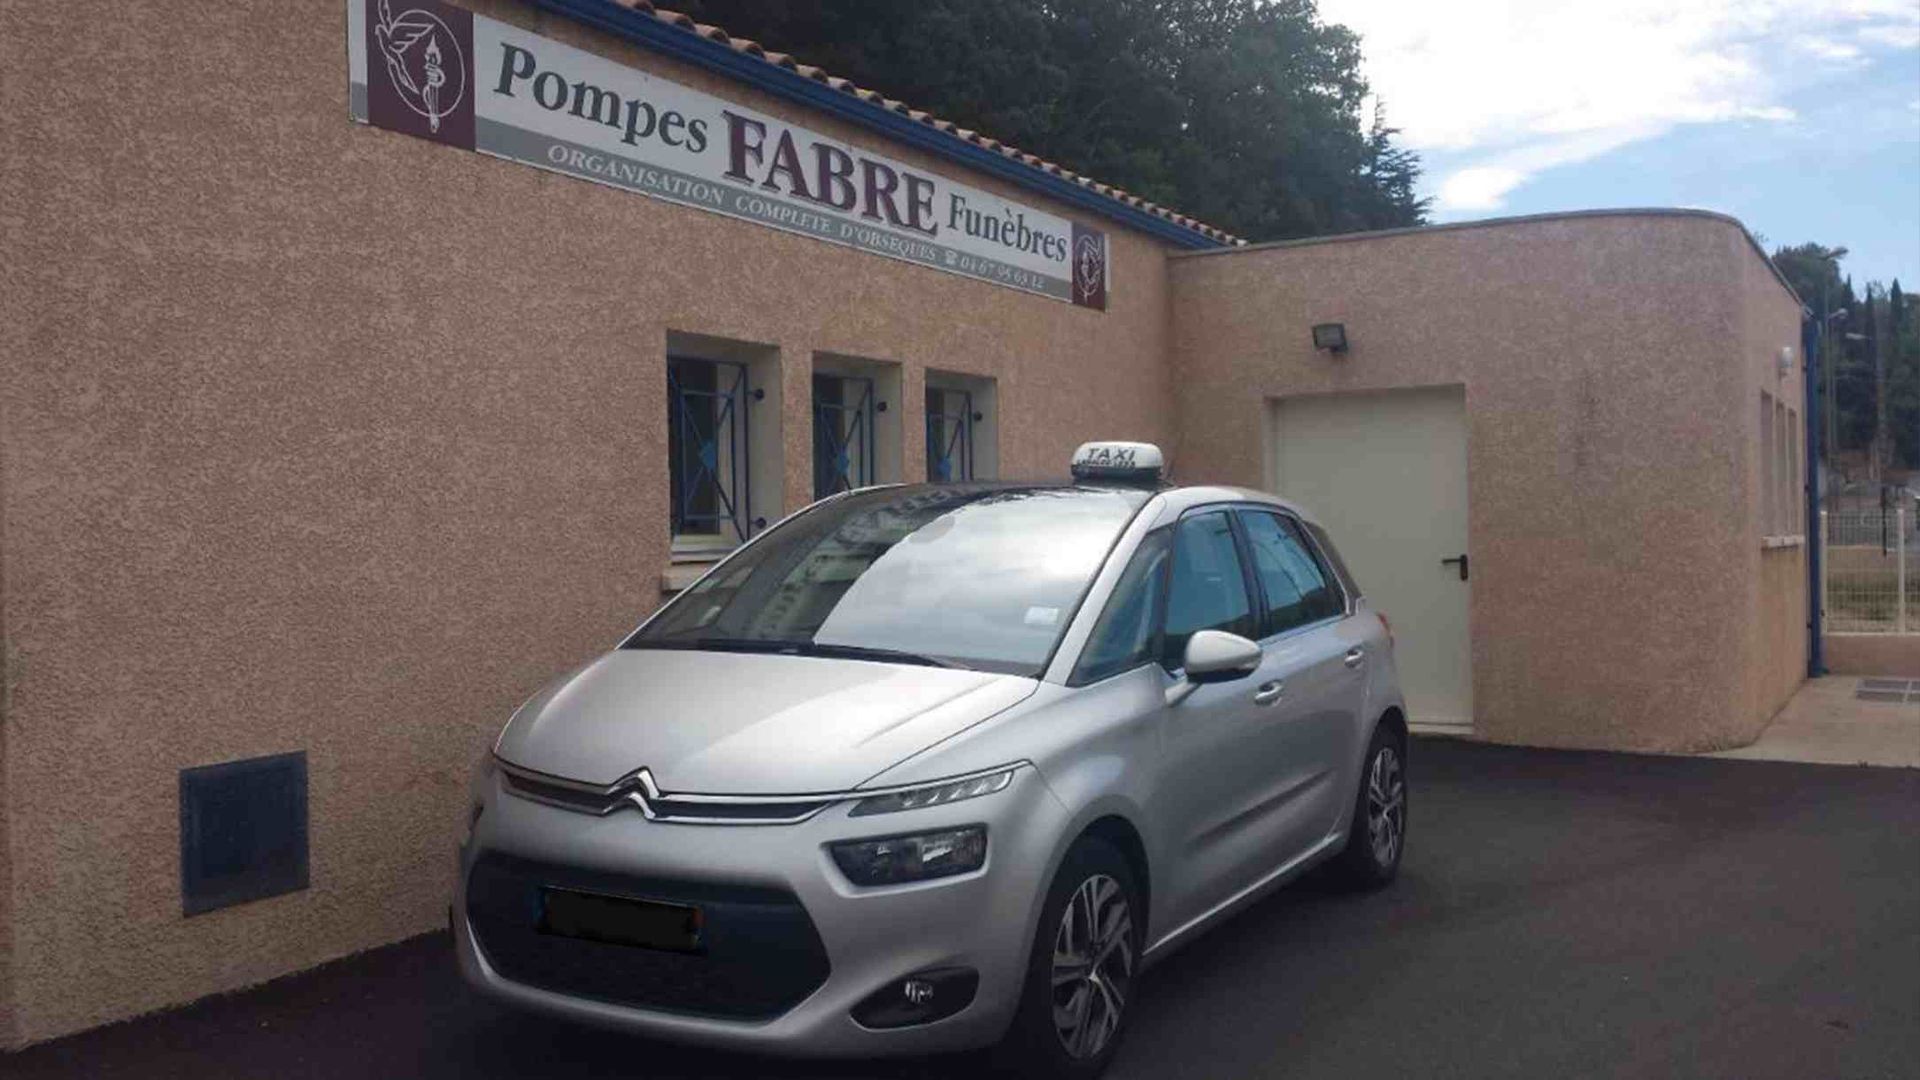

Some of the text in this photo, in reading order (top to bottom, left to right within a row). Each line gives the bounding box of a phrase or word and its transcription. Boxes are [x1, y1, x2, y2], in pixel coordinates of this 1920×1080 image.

[493, 41, 1068, 263] Pompes FABRE Funèbres
[548, 144, 725, 205] ORGANISATION
[735, 195, 831, 233] COMPLETE
[840, 223, 936, 261] D'OBSEQUES
[1087, 448, 1136, 461] TAXI
